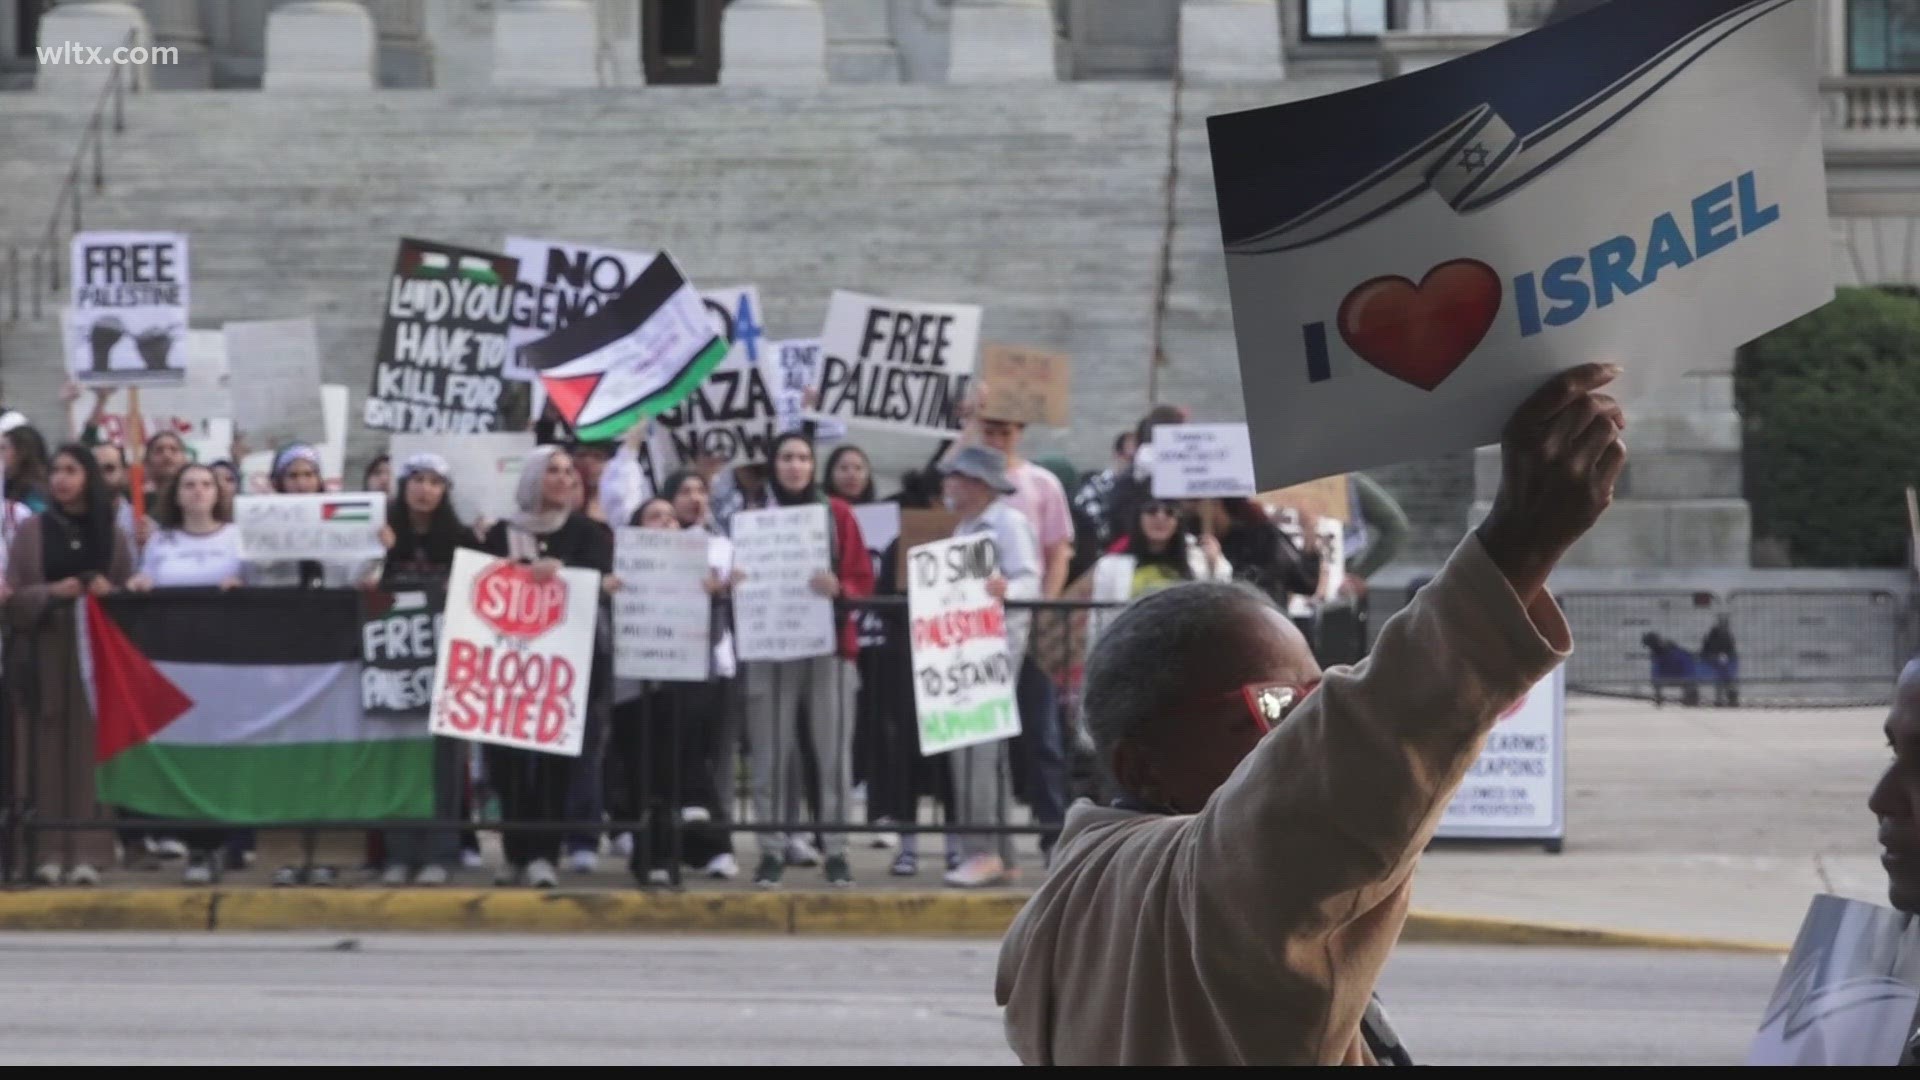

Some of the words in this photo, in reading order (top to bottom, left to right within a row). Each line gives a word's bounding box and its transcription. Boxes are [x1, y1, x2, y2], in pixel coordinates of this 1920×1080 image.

[84, 243, 175, 284] FREE
[547, 248, 626, 294] NO
[1303, 321, 1331, 383] I
[1513, 170, 1780, 338] ISRAEL
[78, 284, 182, 308] PALESTINE
[450, 276, 513, 324] YOU
[394, 321, 472, 371] HAVE
[860, 308, 954, 367] FREE
[377, 361, 441, 404] KILL
[444, 372, 503, 411] FOR
[481, 573, 566, 626] STOP
[448, 639, 576, 698] BLOOD
[1466, 756, 1547, 777] EAPONS
[1486, 734, 1549, 753] EARMS
